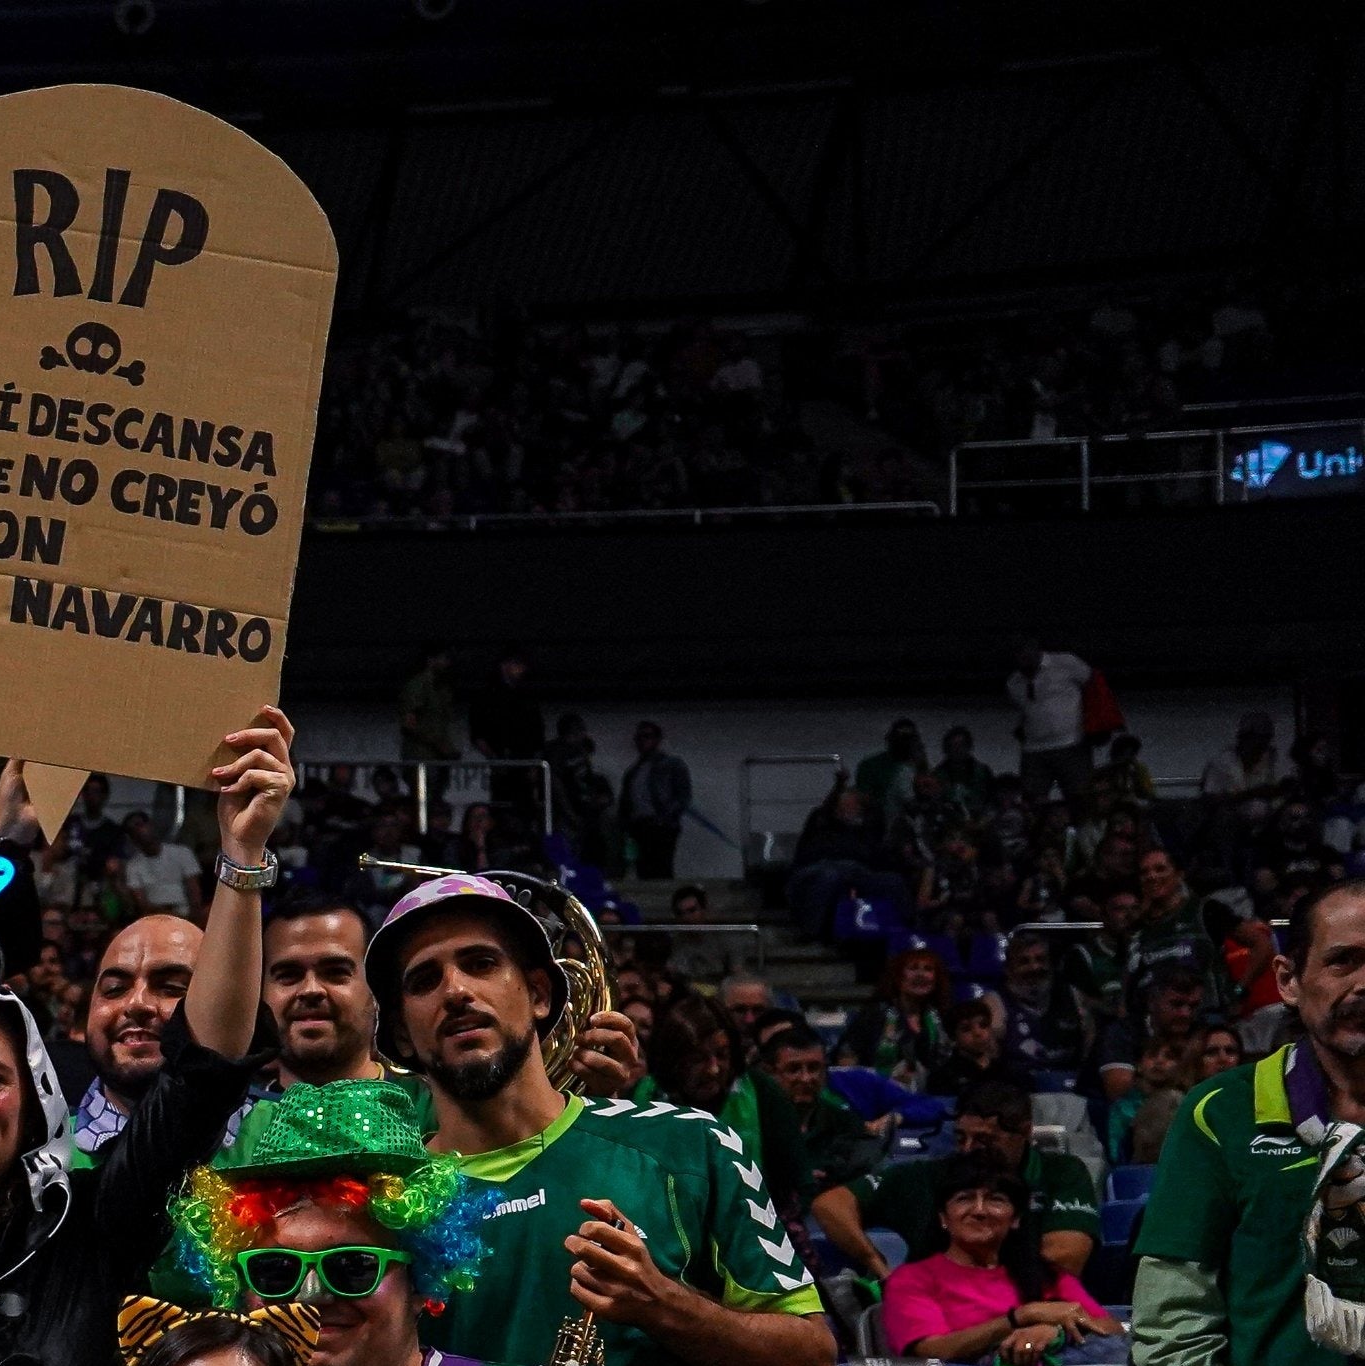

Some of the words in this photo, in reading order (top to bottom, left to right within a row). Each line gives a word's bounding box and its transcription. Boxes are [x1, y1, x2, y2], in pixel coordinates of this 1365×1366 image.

[12, 167, 210, 308] RIP
[28, 393, 278, 477] DESCANSA
[19, 453, 100, 506] NO
[110, 468, 279, 537] CREYÓ
[9, 576, 271, 664] NAVARRO
